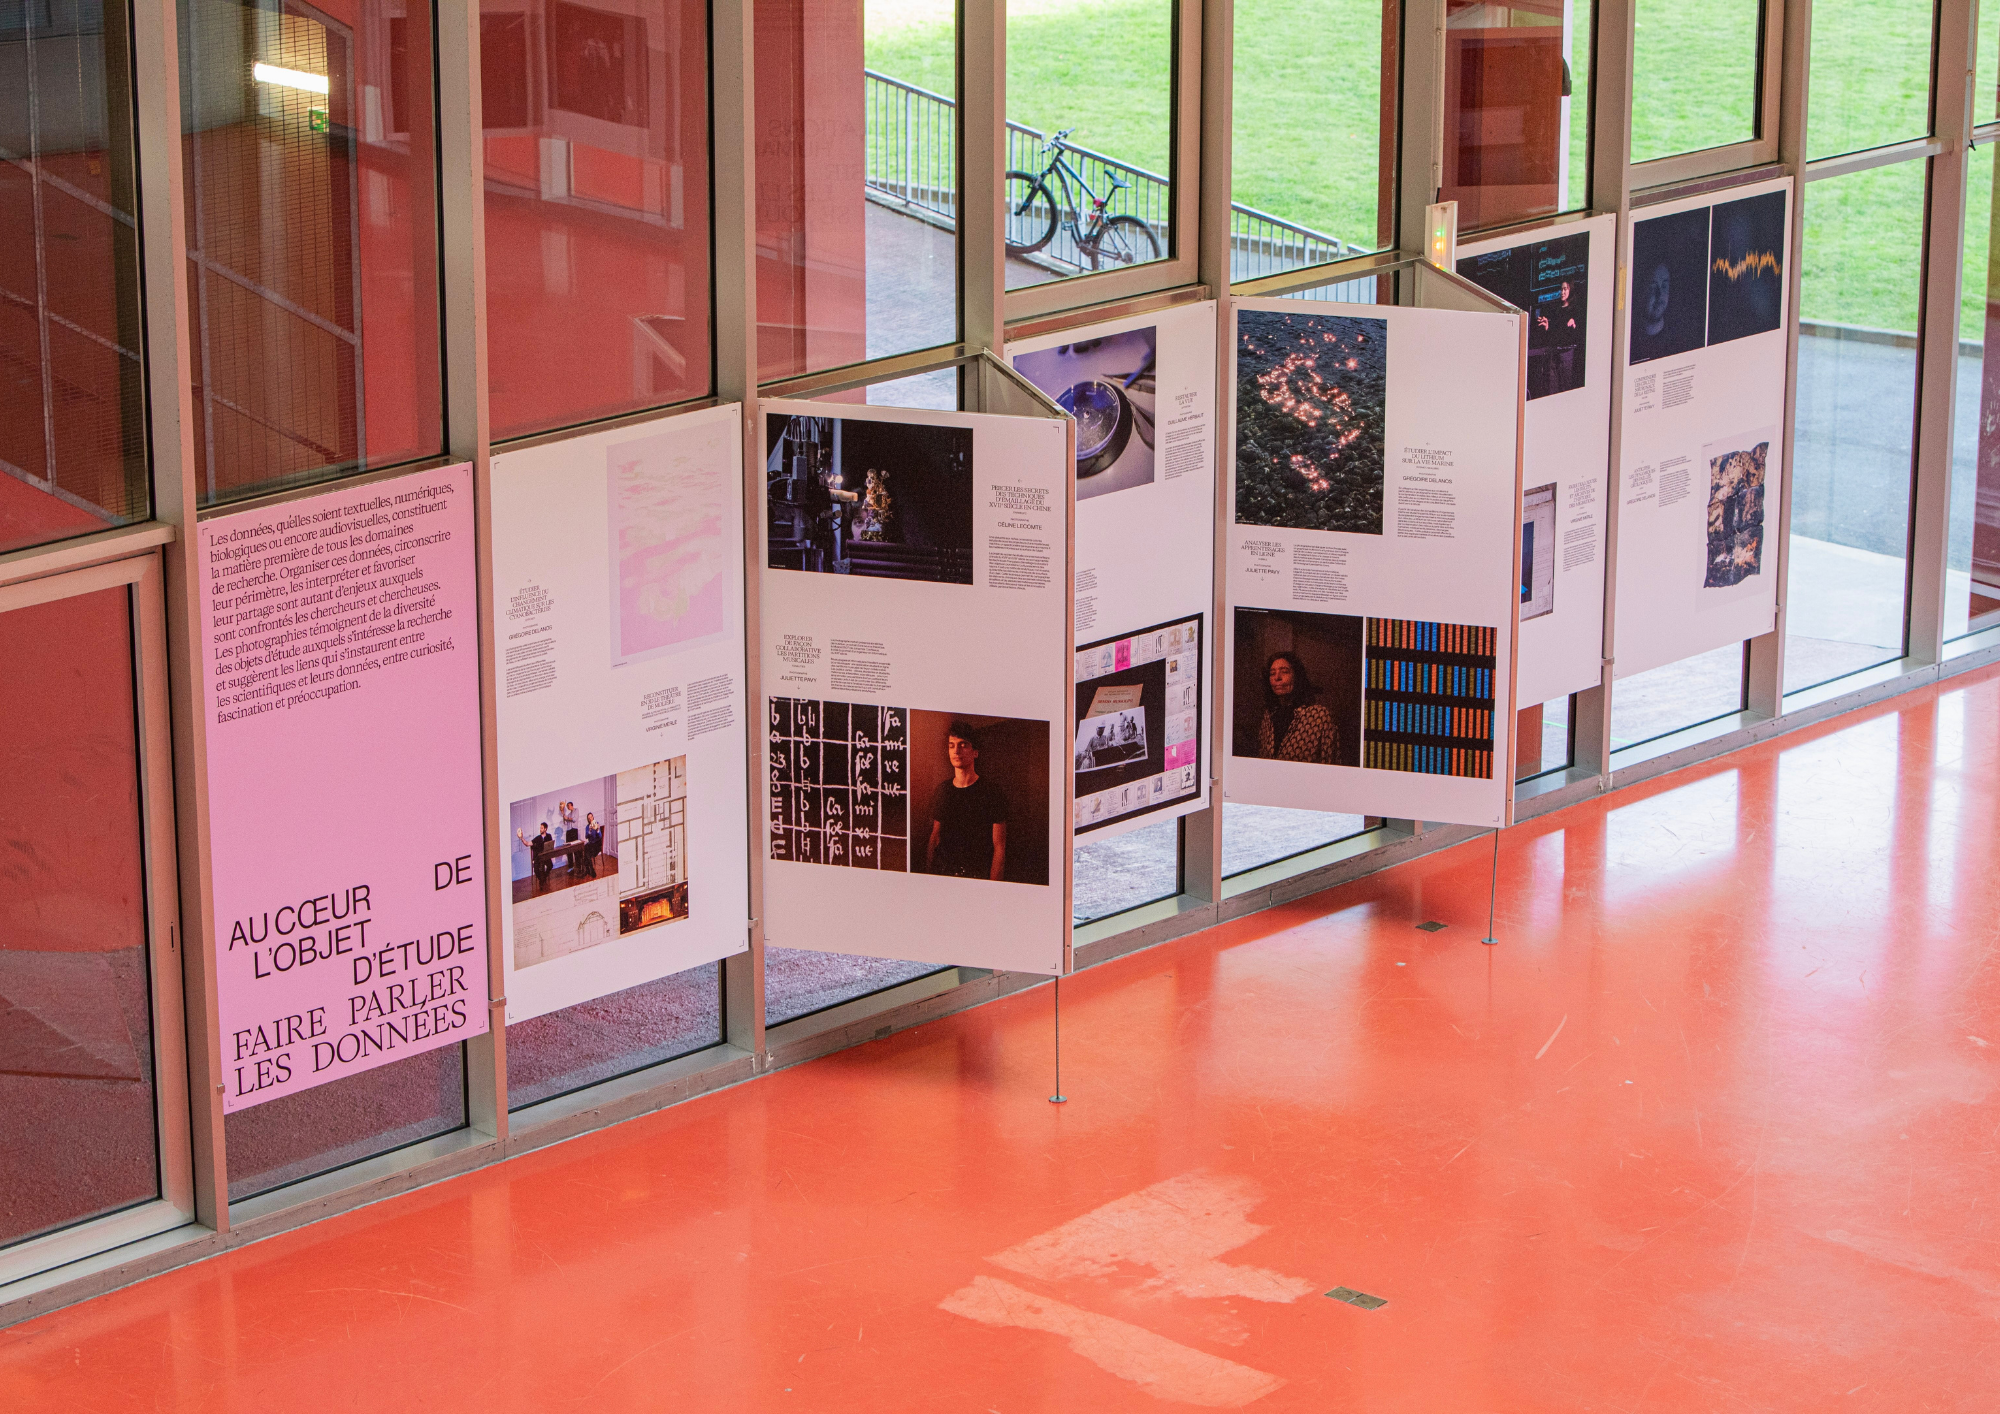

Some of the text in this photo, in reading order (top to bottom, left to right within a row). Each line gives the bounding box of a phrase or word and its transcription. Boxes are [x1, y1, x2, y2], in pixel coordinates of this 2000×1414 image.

[210, 534, 229, 547] Les
[229, 522, 275, 542] données,
[312, 507, 342, 523] soient
[343, 496, 393, 516] textuelles,
[394, 483, 454, 505] numériques,
[210, 499, 447, 563] biologiques ou encore audiovisuelles, constituent
[210, 523, 414, 579] la matière première de tous les domaines
[211, 530, 451, 595] de recherche. Organiser ces données, circonscrire
[212, 555, 416, 612] leur périmètre, les interpréter et favoriser
[213, 614, 234, 628] leur
[235, 605, 274, 626] partage
[276, 598, 298, 613] sont
[300, 589, 333, 607] autant
[379, 567, 424, 588] auxquels
[213, 581, 441, 644] sont confrontés les chercheurs et chercheuses.
[214, 594, 435, 660] Les photographies témoignent de la diversité
[215, 662, 232, 676] des
[234, 656, 263, 672] objets
[302, 633, 346, 654] auxquels
[396, 618, 405, 631] la
[406, 608, 452, 628] recherche
[215, 680, 226, 692] et
[228, 667, 279, 689] suggèrent
[280, 663, 294, 675] les
[296, 658, 319, 672] liens
[321, 650, 338, 668] qui
[399, 631, 425, 646] entre
[216, 636, 455, 708] les scientifiques et leurs données, entre curiosité,
[217, 680, 361, 724] fascination et préoccupation.
[229, 854, 473, 951] AU CŒUR DE
[254, 919, 372, 979] L'OBJET
[353, 924, 474, 985] D'ÉTUDE
[233, 965, 468, 1062] FAIRE PARLER
[235, 999, 467, 1097] LES DONNÉES
